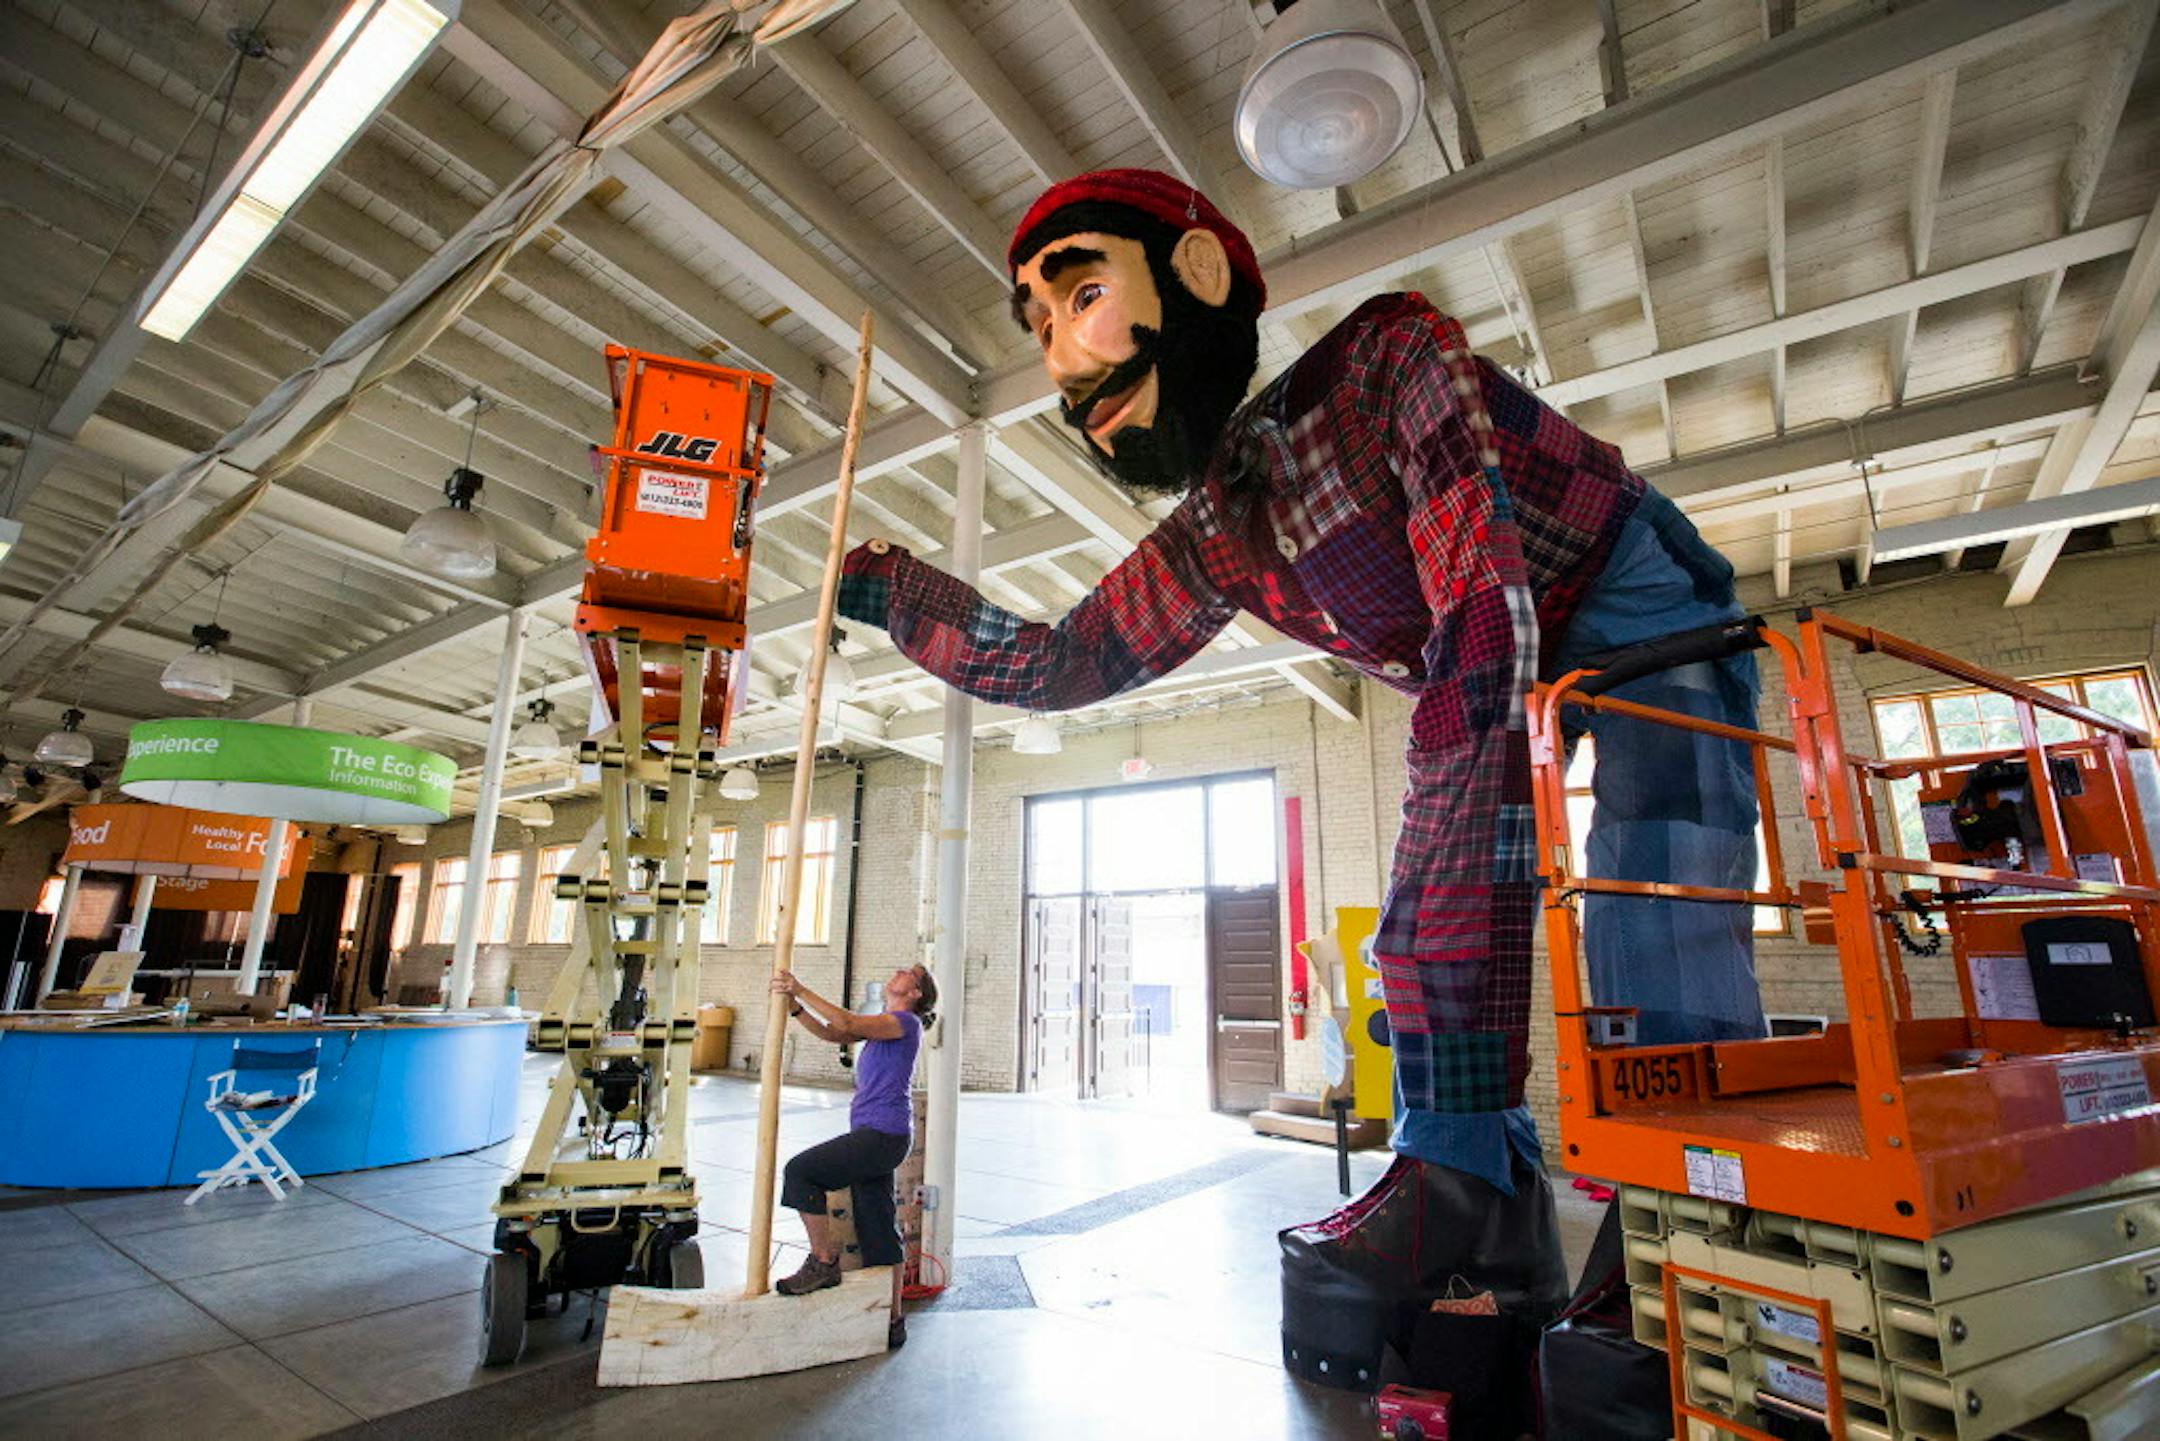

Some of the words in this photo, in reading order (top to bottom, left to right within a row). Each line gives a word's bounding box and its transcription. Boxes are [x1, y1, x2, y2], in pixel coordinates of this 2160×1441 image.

[635, 431, 720, 463] JLG
[330, 746, 377, 771] The
[382, 755, 415, 778] Eco
[330, 769, 417, 795] Information
[71, 818, 111, 845] ood
[192, 824, 245, 841] Healthy
[206, 839, 241, 851] Local
[157, 875, 209, 892] Stage
[1614, 1056, 1681, 1100] 4055
